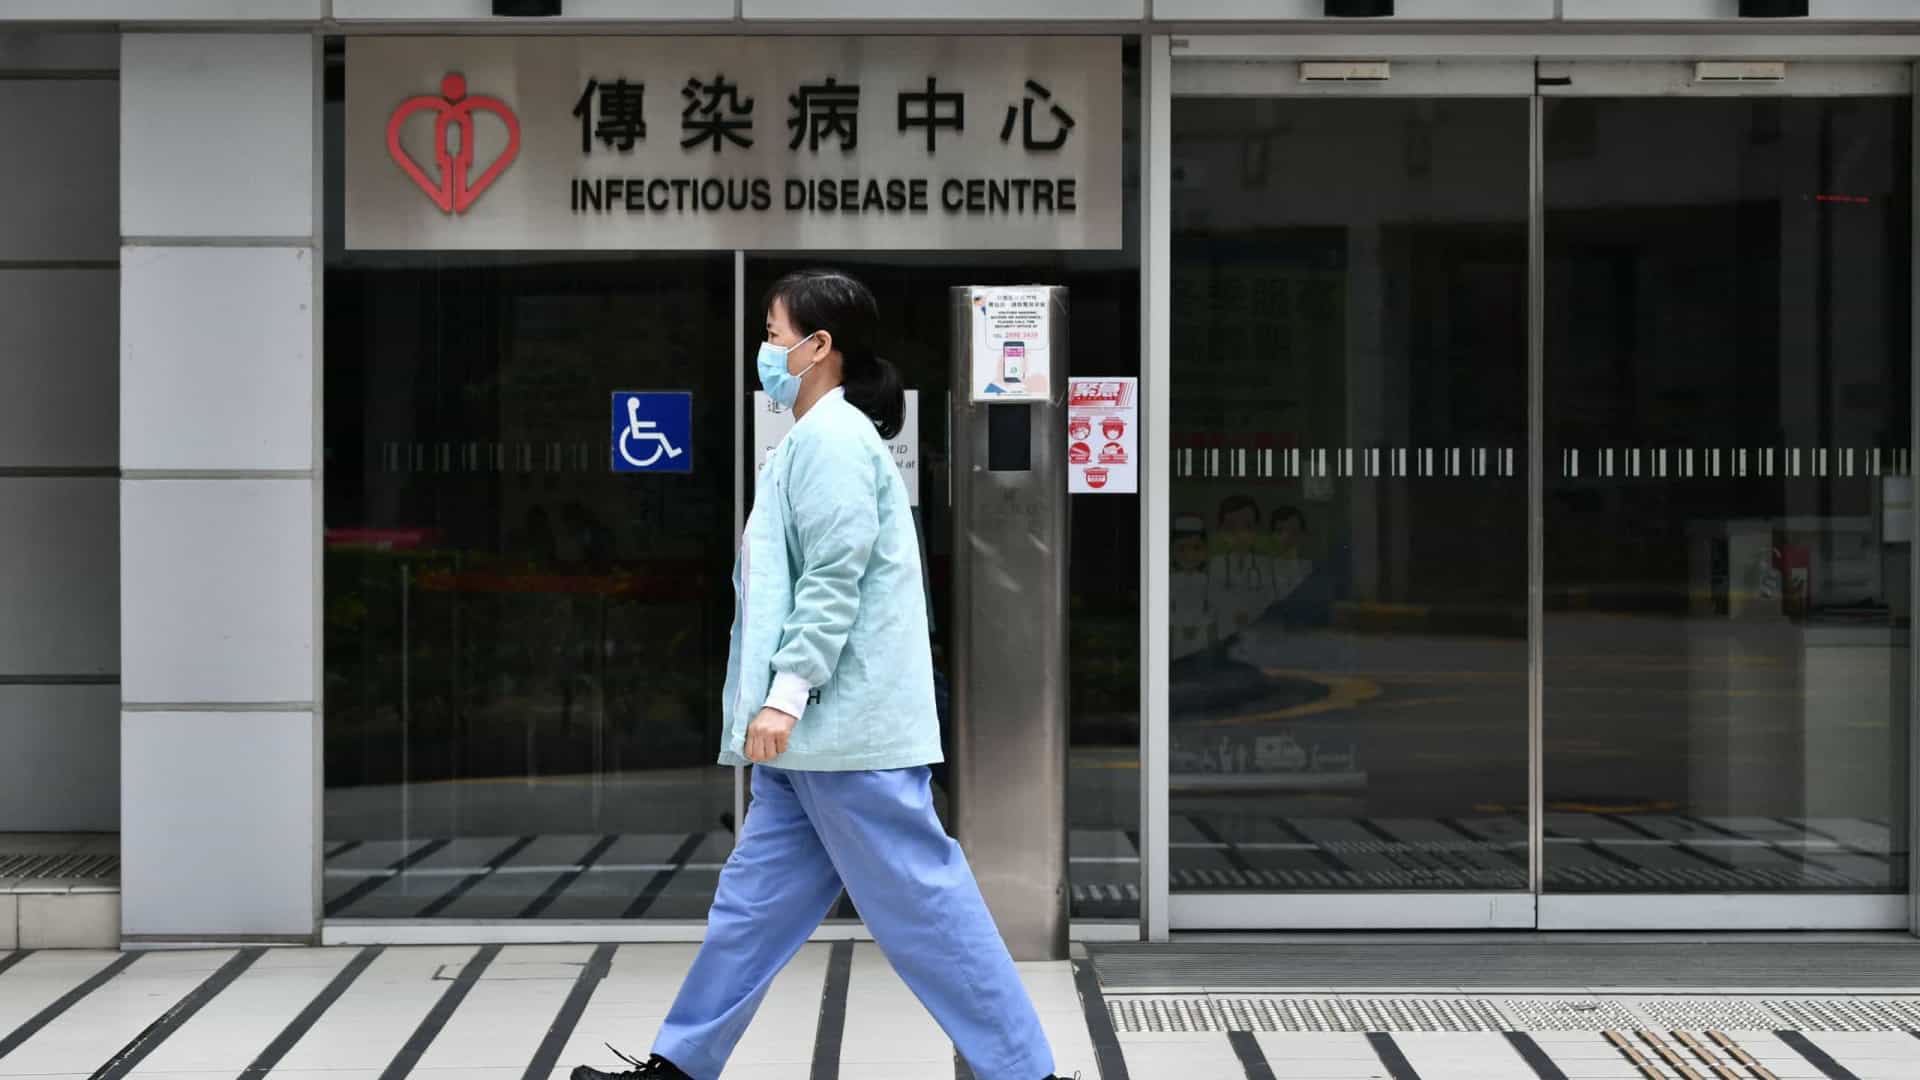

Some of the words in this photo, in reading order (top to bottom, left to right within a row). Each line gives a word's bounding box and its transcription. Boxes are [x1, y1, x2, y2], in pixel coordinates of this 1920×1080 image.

[573, 76, 1076, 153] 傳染病中心
[572, 179, 772, 212] INFECTIOUS
[785, 179, 928, 212] DISEASE
[942, 179, 1077, 212] CENTRE
[896, 444, 908, 455] ID
